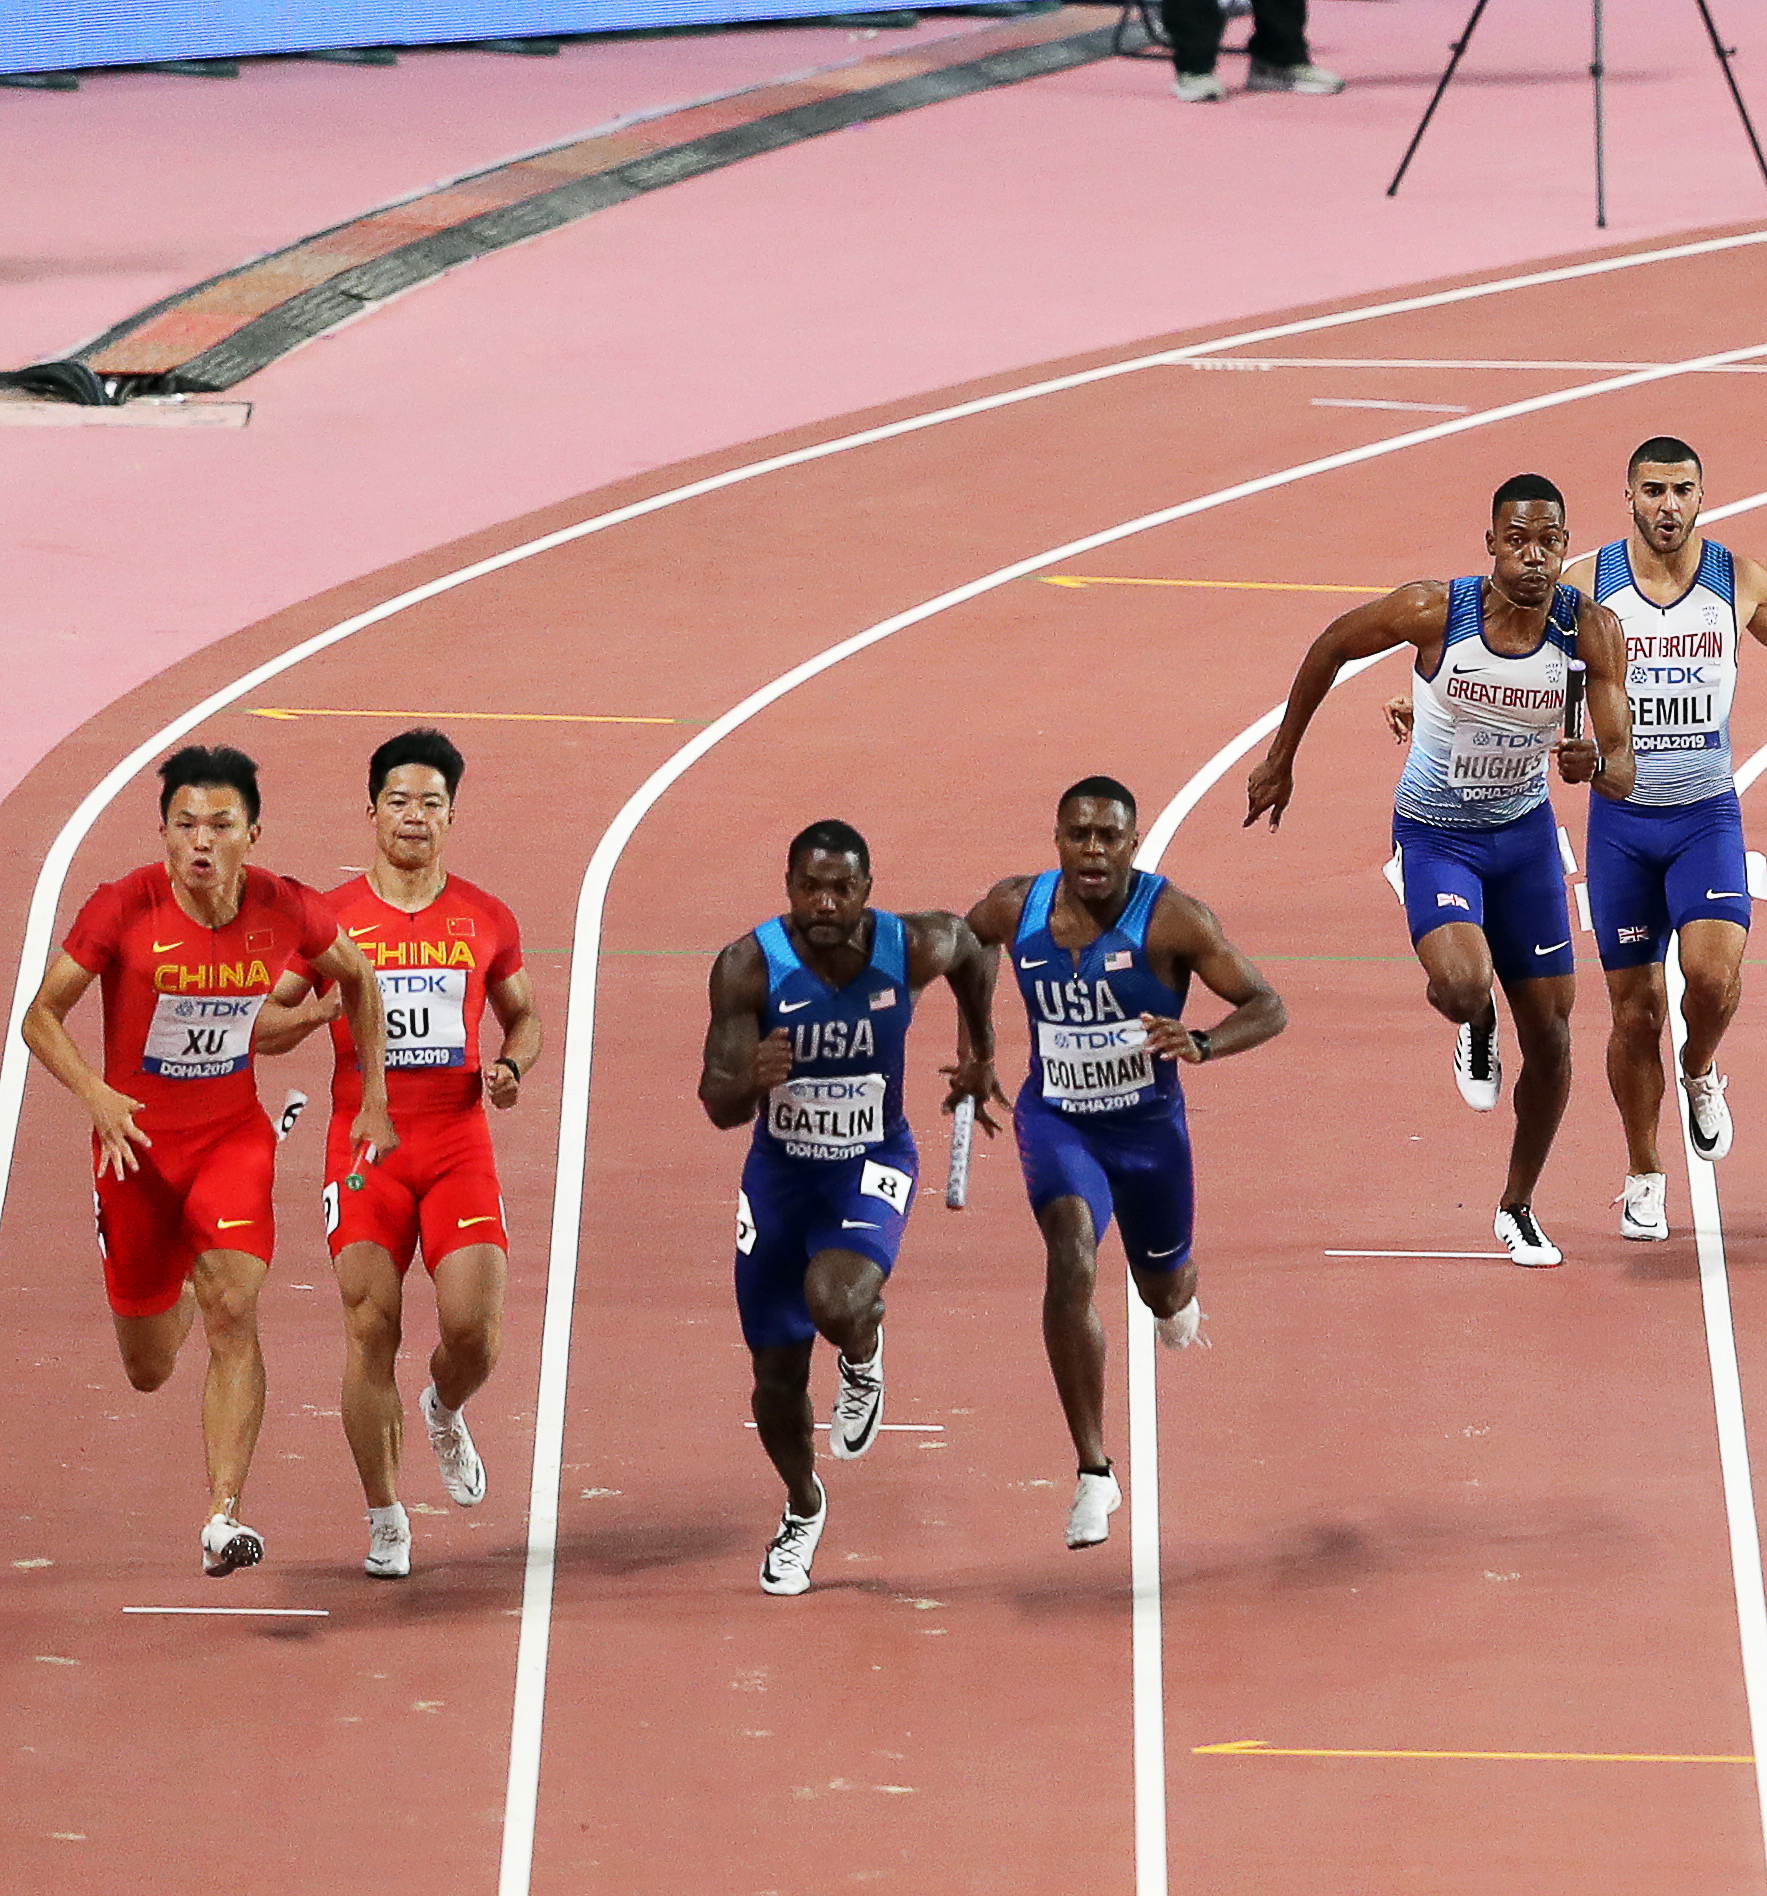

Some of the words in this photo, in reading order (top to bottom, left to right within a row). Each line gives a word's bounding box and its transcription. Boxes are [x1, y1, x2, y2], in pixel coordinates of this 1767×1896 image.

[1625, 636, 1657, 661] EAT
[1658, 631, 1722, 658] BRITAIN
[1647, 666, 1706, 684] TDK
[1447, 677, 1501, 705] GREAT
[1502, 687, 1564, 709] BRITAIN
[1491, 731, 1543, 748] TDK
[1633, 734, 1706, 751] DOHA2019
[1454, 750, 1545, 780] HUGHES
[154, 960, 271, 991] CHINA
[387, 975, 447, 993] TDK
[197, 1000, 252, 1017] TDK
[1034, 979, 1126, 1022] USA
[386, 1008, 430, 1040] SU
[181, 1028, 229, 1056] XU
[795, 1017, 874, 1063] USA
[1069, 1029, 1129, 1049] TDK
[160, 1060, 235, 1078] DOHA2019
[385, 1049, 450, 1067] OHA2019
[1046, 1052, 1147, 1090] COLEMAN
[811, 1082, 867, 1099] TDK
[775, 1103, 874, 1138] GATLIN
[878, 1176, 898, 1199] 8
